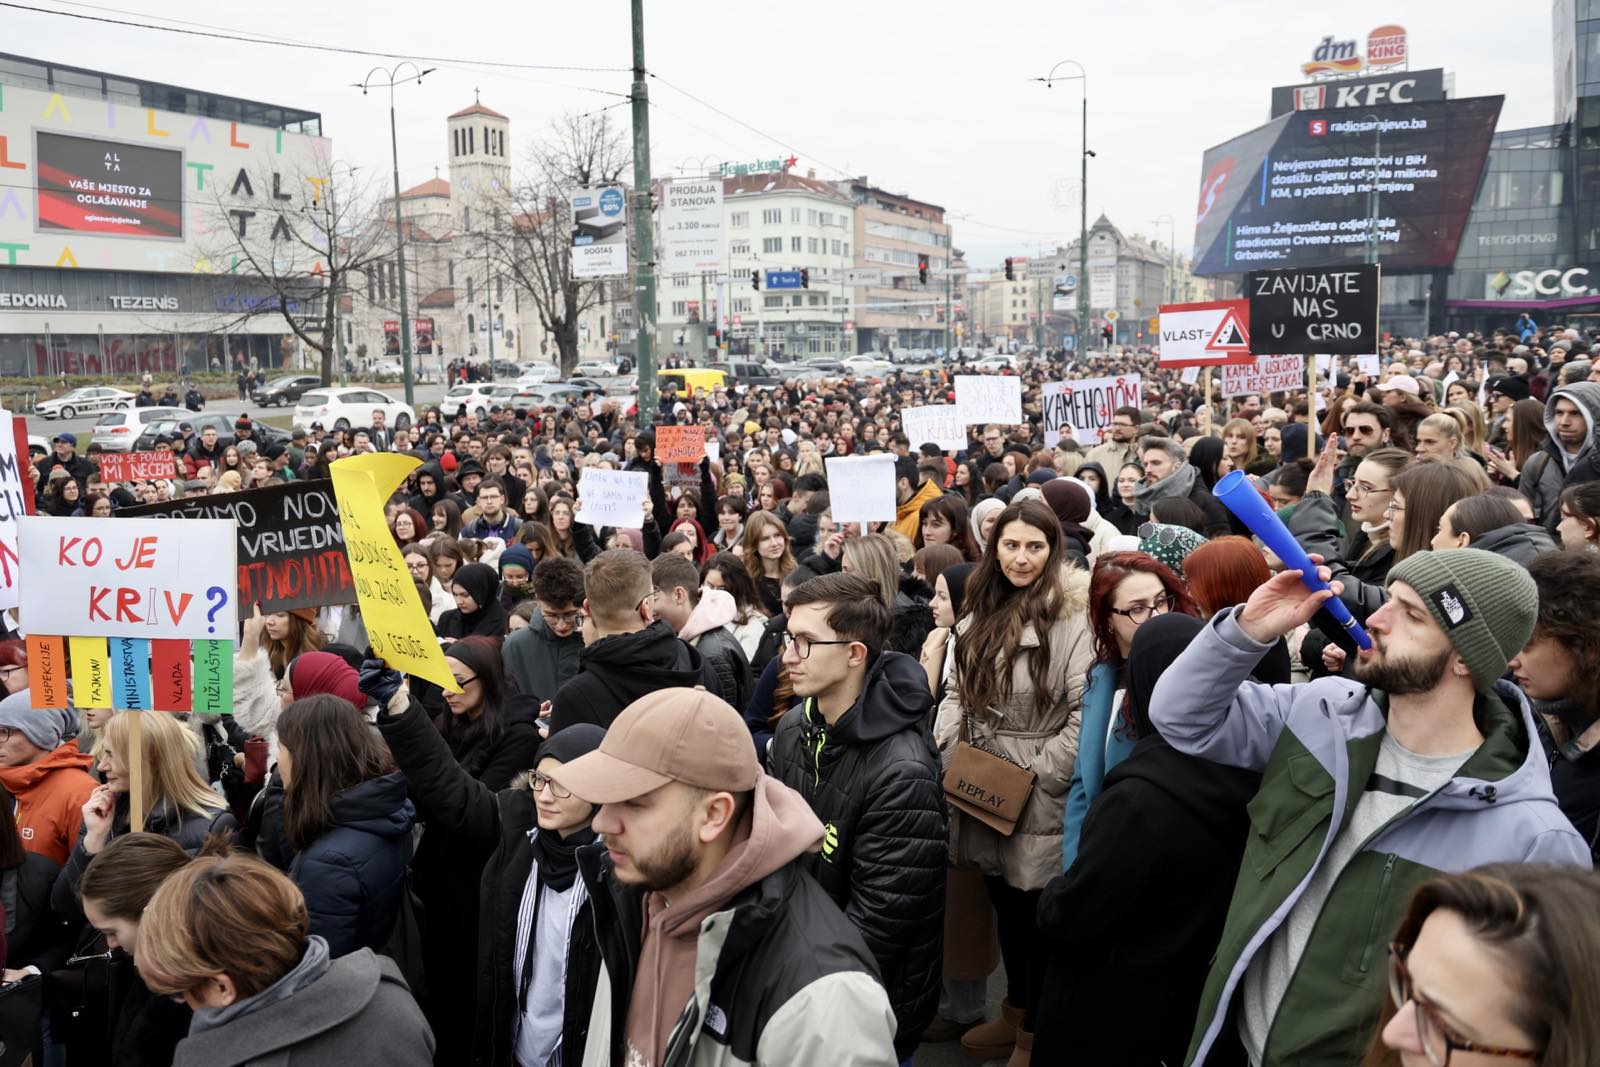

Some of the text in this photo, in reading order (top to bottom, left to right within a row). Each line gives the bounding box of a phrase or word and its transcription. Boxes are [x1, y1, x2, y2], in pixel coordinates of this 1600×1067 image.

[1368, 36, 1406, 47] BURGER
[1367, 45, 1405, 58] KING
[1335, 79, 1416, 108] KFC
[719, 158, 780, 176] Heineken
[1273, 156, 1349, 172] Nevjerovatno!
[1395, 157, 1403, 165] u
[1405, 154, 1428, 165] BiH
[1314, 171, 1347, 184] cijenu
[1349, 168, 1363, 180] od
[68, 178, 152, 197] VAŠE MJESTO ZA
[669, 184, 717, 196] PRODAJA
[1294, 189, 1302, 197] a
[1302, 182, 1356, 198] potražnja
[1377, 182, 1414, 195] enjava
[77, 194, 148, 209] OGLAŠAVANJE
[670, 196, 716, 207] STANOVA
[676, 221, 700, 231] 3.300
[1235, 223, 1271, 236] Himna
[1235, 235, 1291, 249] stadionom
[1292, 234, 1330, 246] Crvene
[1256, 271, 1361, 296] ZAVIJATE
[1514, 266, 1589, 296] SCC
[1293, 296, 1339, 318] NAS
[1271, 322, 1363, 341] U CRNO
[1226, 357, 1301, 379] KAMEN USKORO
[1226, 378, 1243, 394] IZA
[127, 453, 137, 463] SE
[103, 464, 123, 480] MI
[58, 535, 103, 567] KO
[114, 535, 159, 571] JE
[43, 641, 56, 706] INSPEKCIJE
[90, 658, 102, 704] TAJKUNI
[122, 637, 141, 711] MINISTARSTVA
[173, 661, 186, 704] VLADA
[203, 639, 222, 711] TUŽILAŠTVO
[957, 779, 1006, 809] REPLAY
